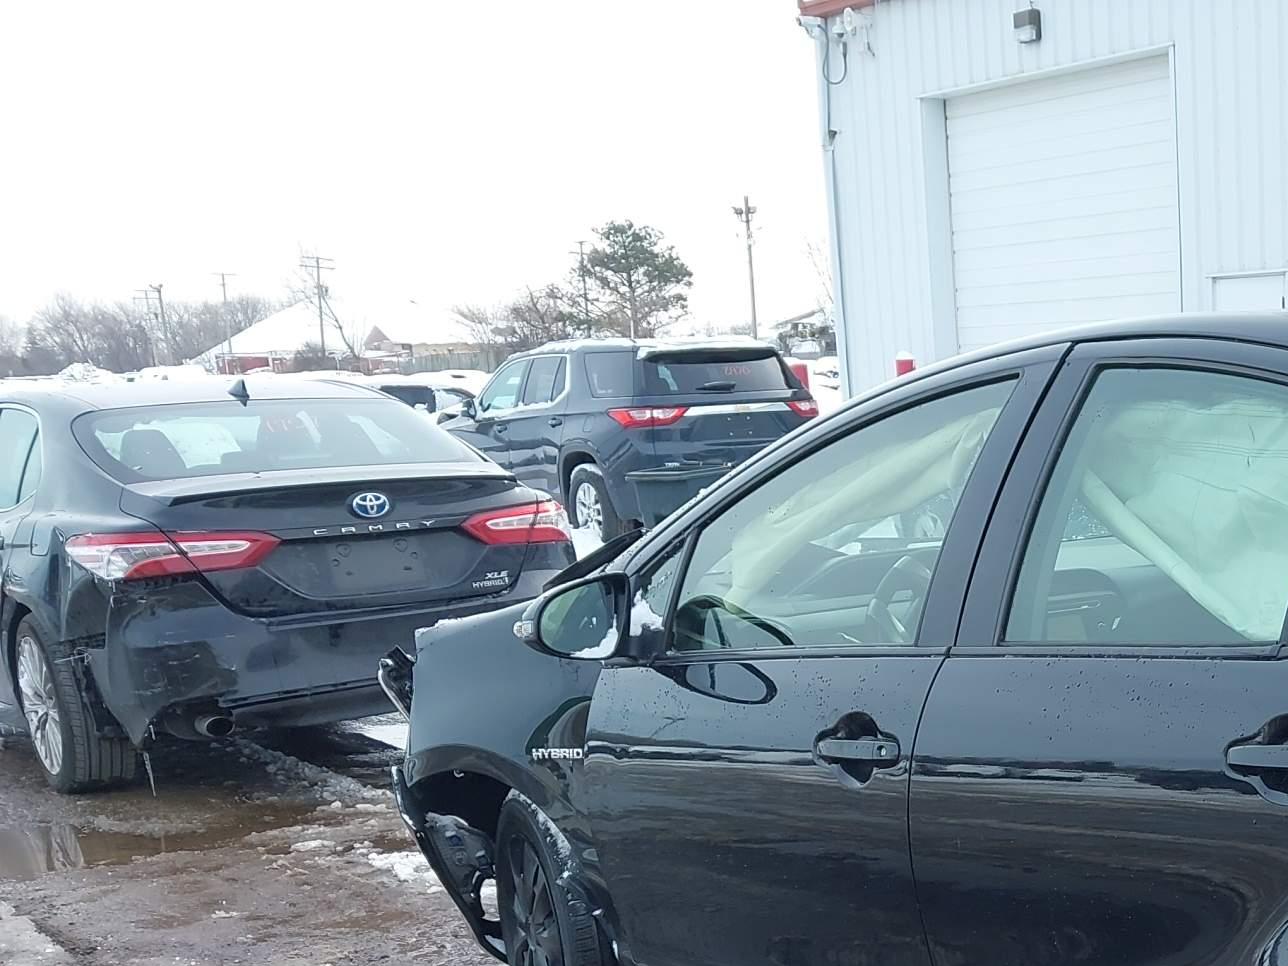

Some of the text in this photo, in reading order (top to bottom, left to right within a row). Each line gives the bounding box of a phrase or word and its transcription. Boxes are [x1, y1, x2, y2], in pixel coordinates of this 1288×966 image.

[313, 520, 435, 535] CAMRY
[485, 570, 509, 579] XLE
[472, 578, 505, 589] HYBRID
[532, 748, 583, 760] HYBRID
